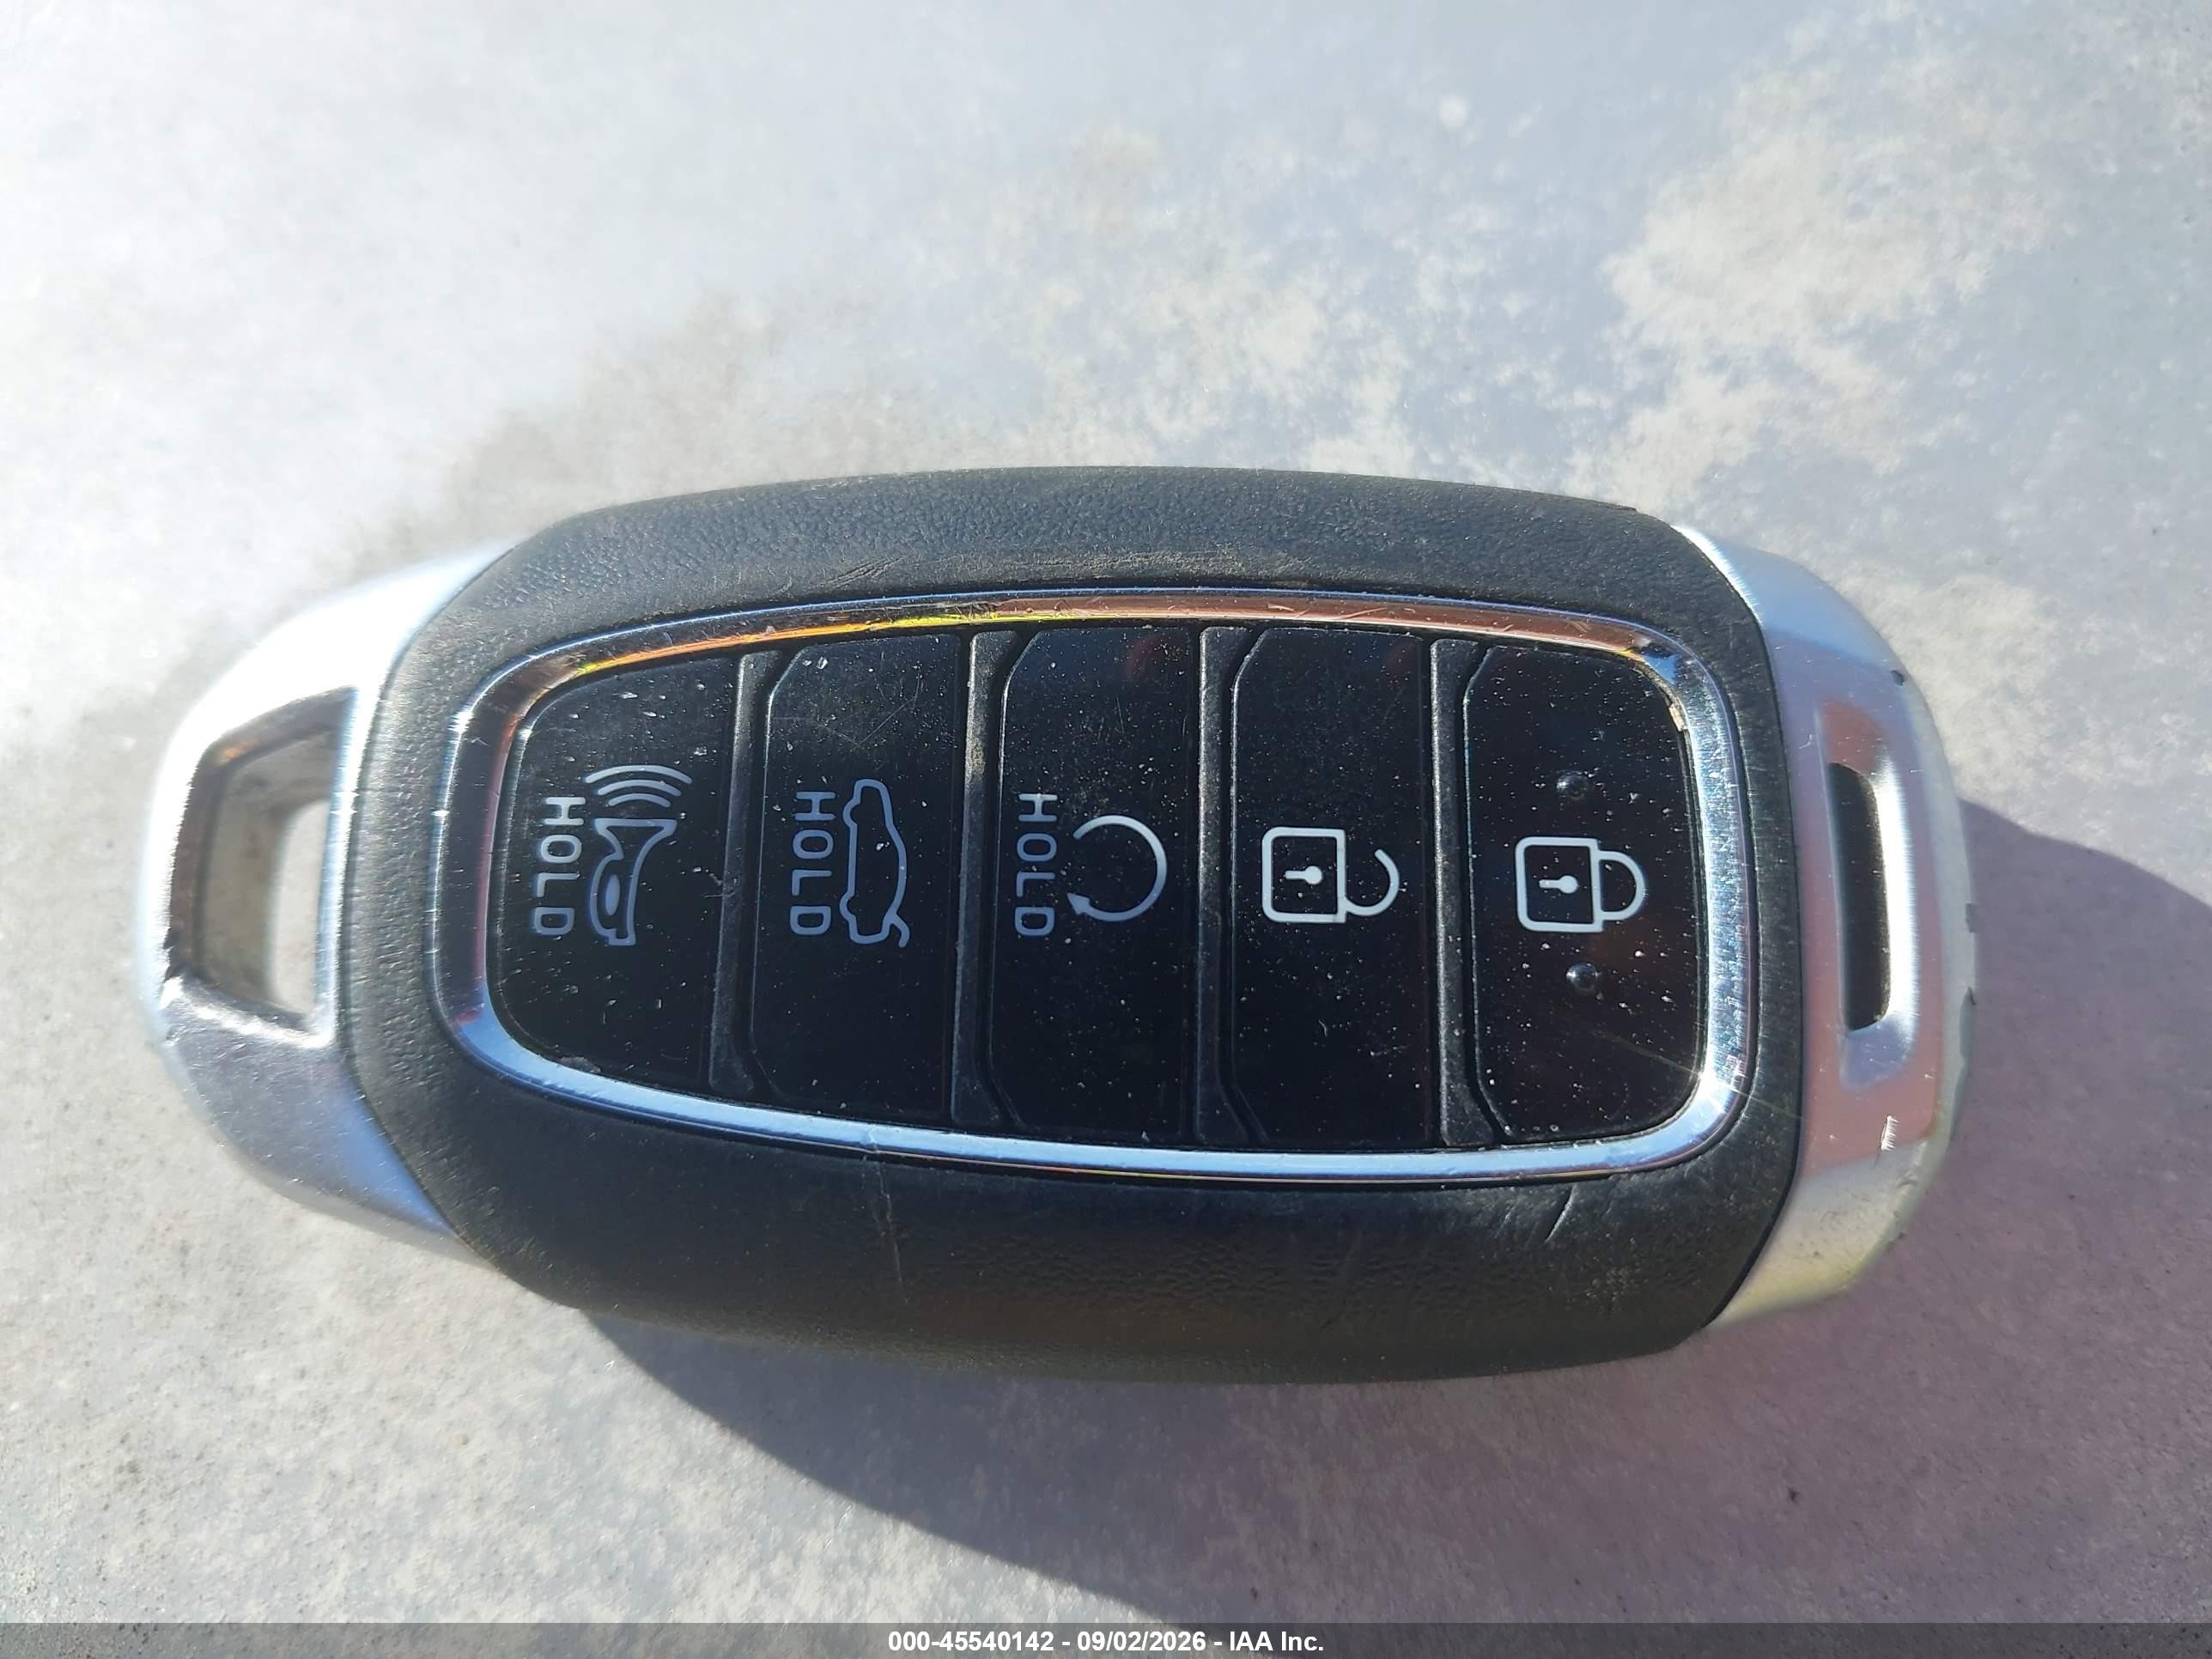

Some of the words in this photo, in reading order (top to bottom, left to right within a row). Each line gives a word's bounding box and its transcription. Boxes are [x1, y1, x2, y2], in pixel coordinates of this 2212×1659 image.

[532, 796, 586, 937] HOLD
[789, 791, 836, 936] HOLD
[1014, 793, 1058, 938] HOLD
